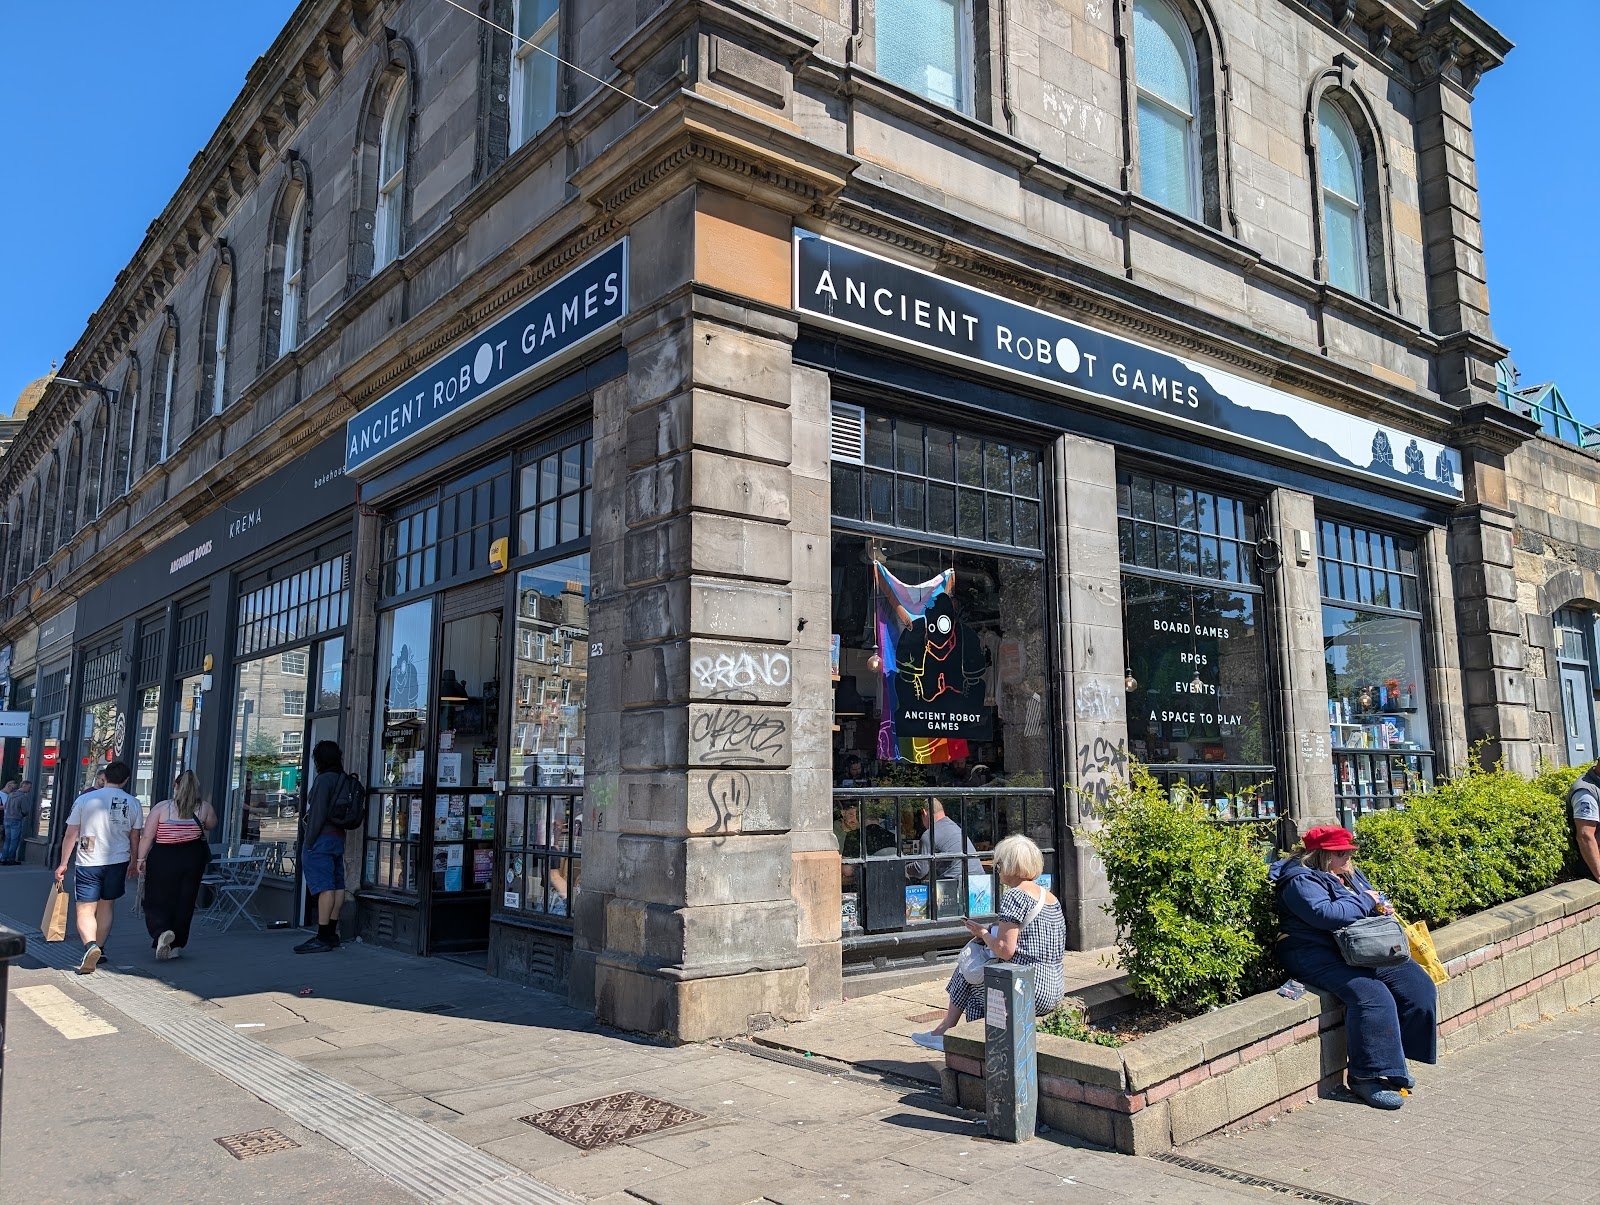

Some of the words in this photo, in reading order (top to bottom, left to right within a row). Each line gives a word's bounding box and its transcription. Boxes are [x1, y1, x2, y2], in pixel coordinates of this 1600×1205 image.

[815, 270, 978, 340] ANCIENT
[1112, 362, 1200, 409] GAMES
[348, 392, 426, 458] ANCIENT
[521, 272, 618, 354] GAMES
[229, 508, 261, 539] KREMA
[1153, 619, 1191, 635] BOARD
[1194, 624, 1230, 639] GAMES
[591, 643, 603, 657] 23
[1180, 652, 1208, 666] RPGS
[1175, 681, 1216, 695] EVENTS
[904, 710, 947, 723] ANCIENT
[949, 711, 981, 723] ROBOT
[1149, 710, 1158, 721] A
[1161, 710, 1196, 724] SPACE
[1200, 712, 1214, 725] TO
[1217, 713, 1242, 726] PLAY
[927, 721, 960, 731] GAMES
